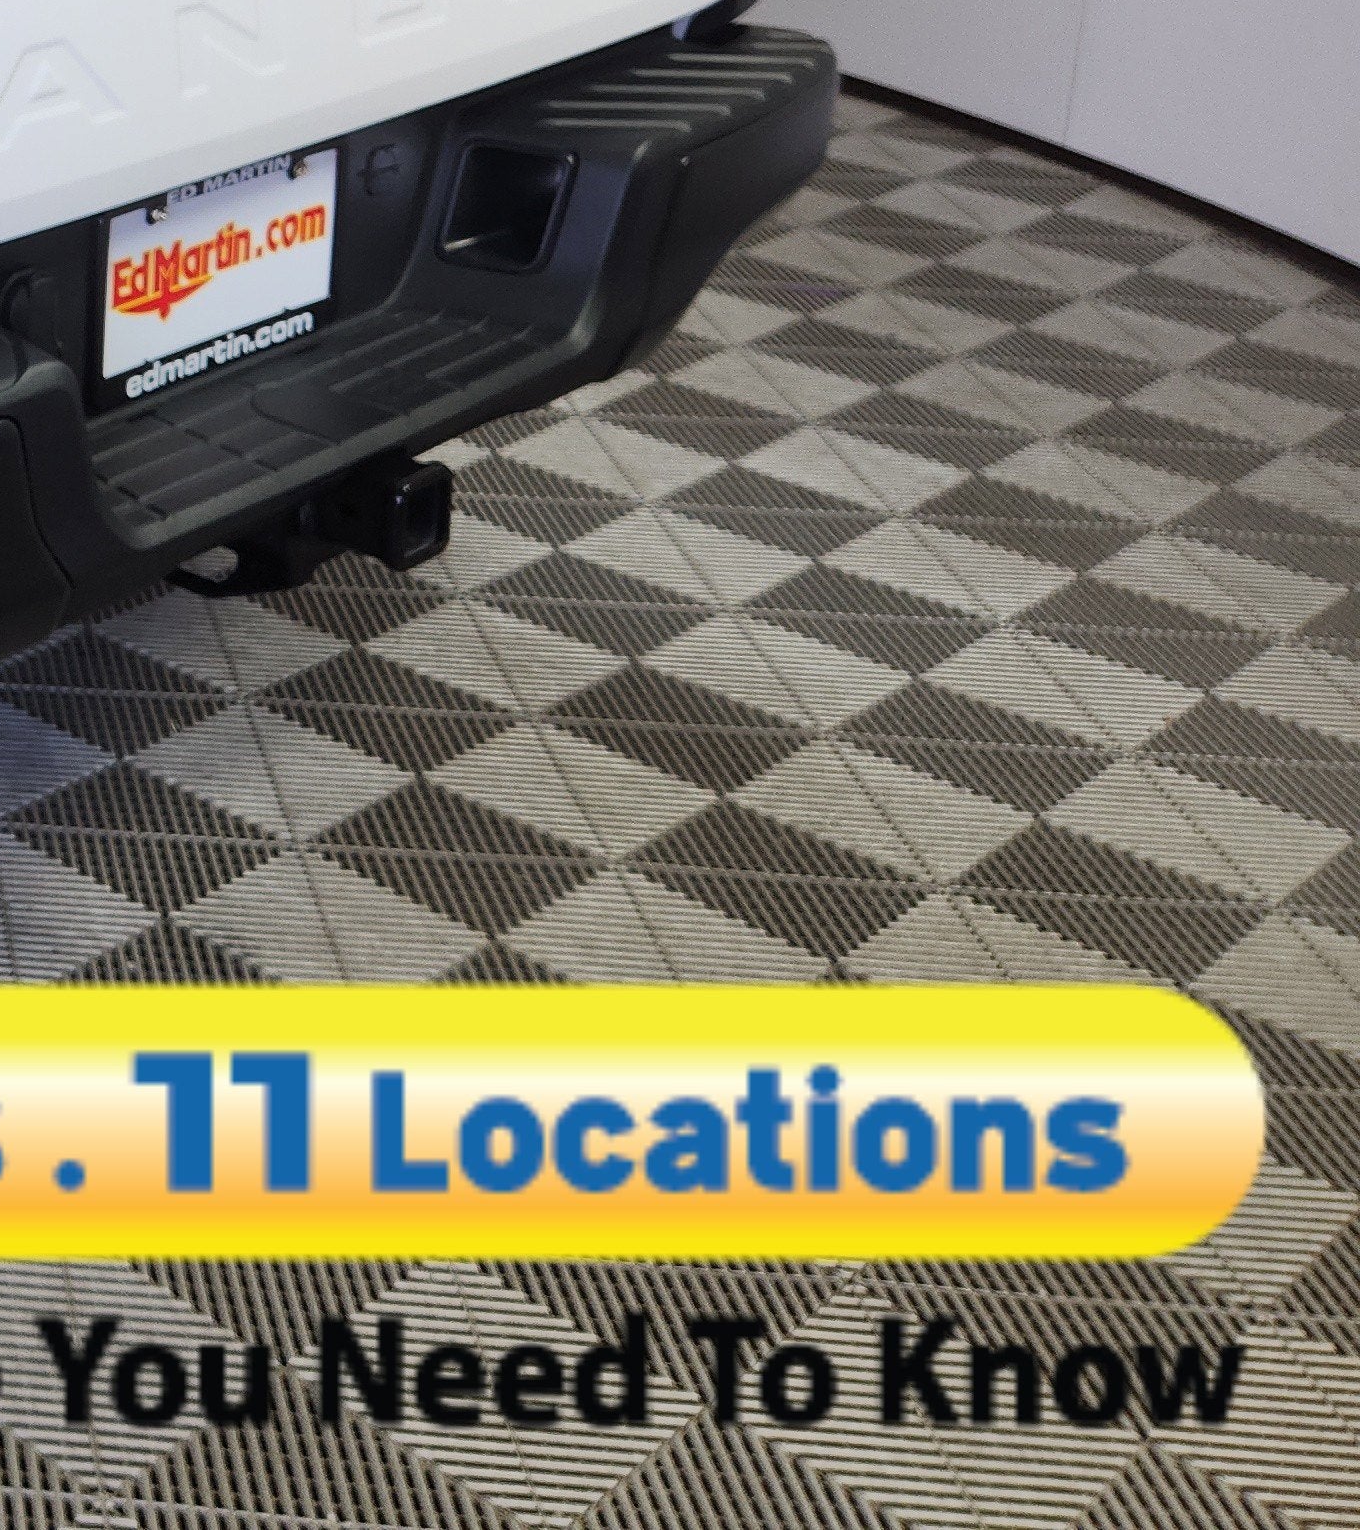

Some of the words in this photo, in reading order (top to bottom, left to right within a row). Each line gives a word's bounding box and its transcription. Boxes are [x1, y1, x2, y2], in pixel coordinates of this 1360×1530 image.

[166, 181, 200, 206] ED
[202, 153, 292, 194] MARTIN
[125, 310, 315, 400] edmartin.com
